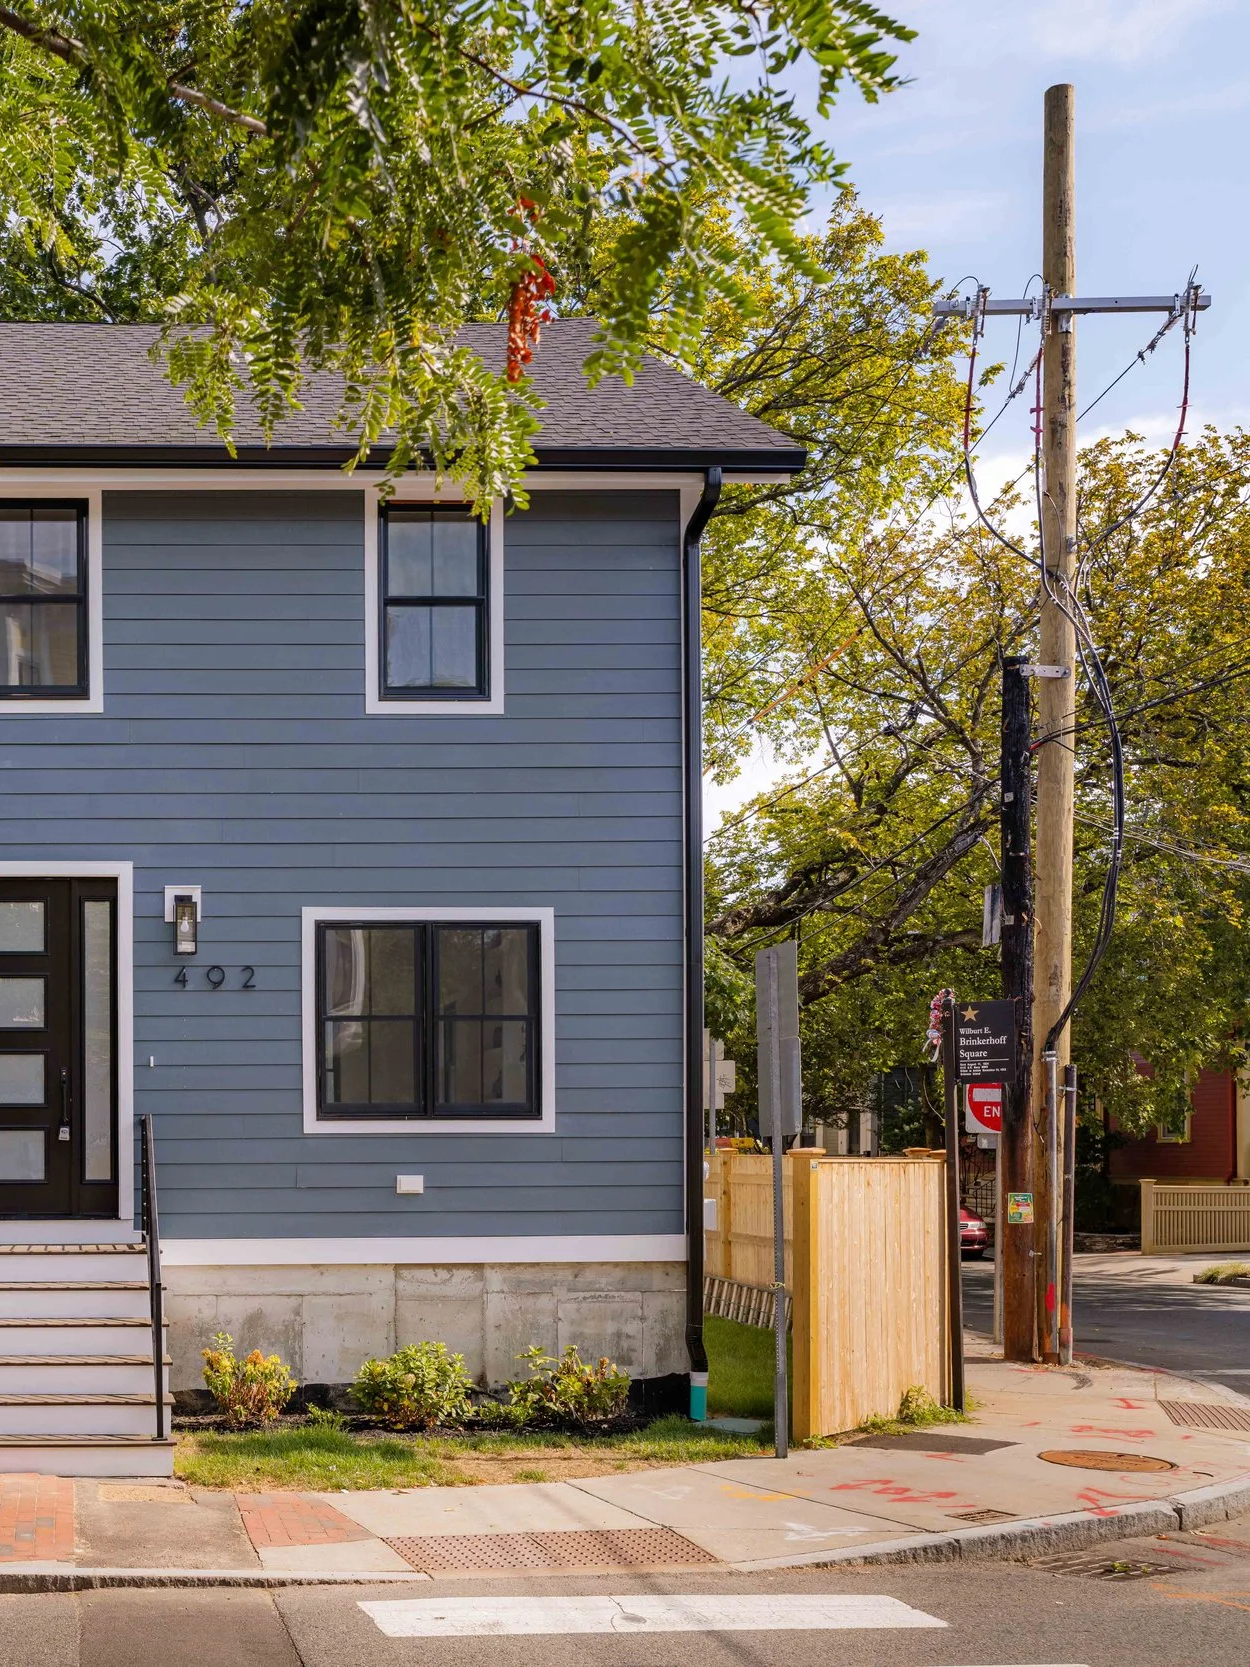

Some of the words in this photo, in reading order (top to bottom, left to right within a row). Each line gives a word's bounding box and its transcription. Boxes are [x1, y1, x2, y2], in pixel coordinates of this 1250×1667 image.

[174, 966, 256, 989] 492
[959, 1027, 983, 1035] Wilburt
[984, 1026, 991, 1034] E.
[960, 1035, 1007, 1046] Brinkerhoff
[960, 1049, 988, 1060] Square
